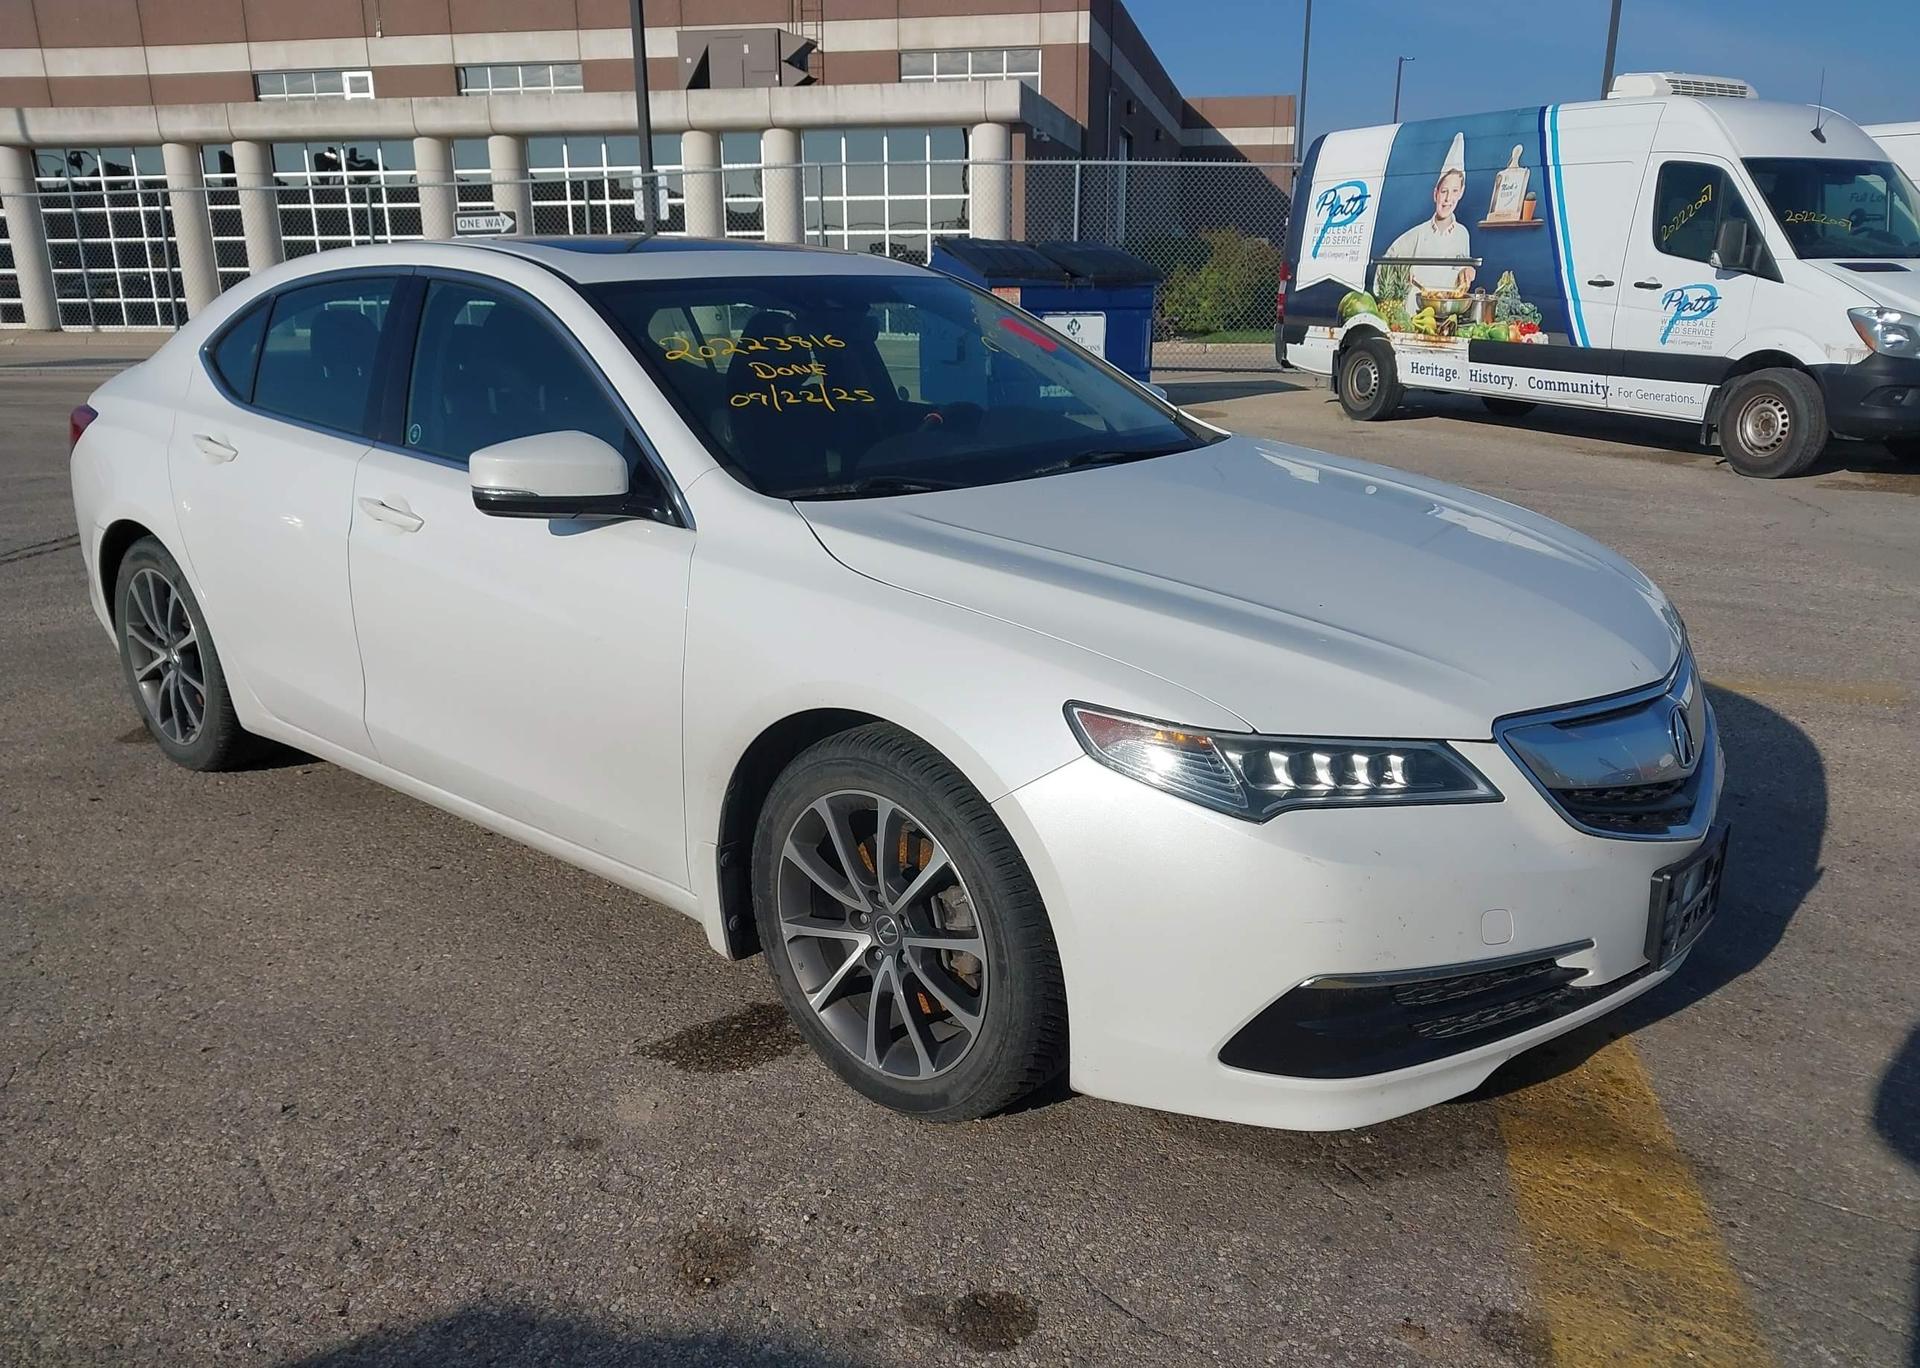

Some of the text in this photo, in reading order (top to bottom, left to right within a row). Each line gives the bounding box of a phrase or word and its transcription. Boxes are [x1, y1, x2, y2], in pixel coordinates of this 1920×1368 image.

[1315, 188, 1371, 217] Pratts
[459, 217, 506, 229] ONE WAY
[1313, 224, 1365, 235] WOLESALE
[1312, 235, 1363, 246] FOD SERVICE
[1661, 288, 1722, 312] Pratts
[1659, 325, 1715, 337] FOD SERVICE
[1660, 318, 1717, 328] WOLESALE
[659, 333, 846, 361] 20223816
[1411, 361, 1703, 405] Heritage. History. Community. For Generations...
[730, 383, 877, 413] 09/22/25
